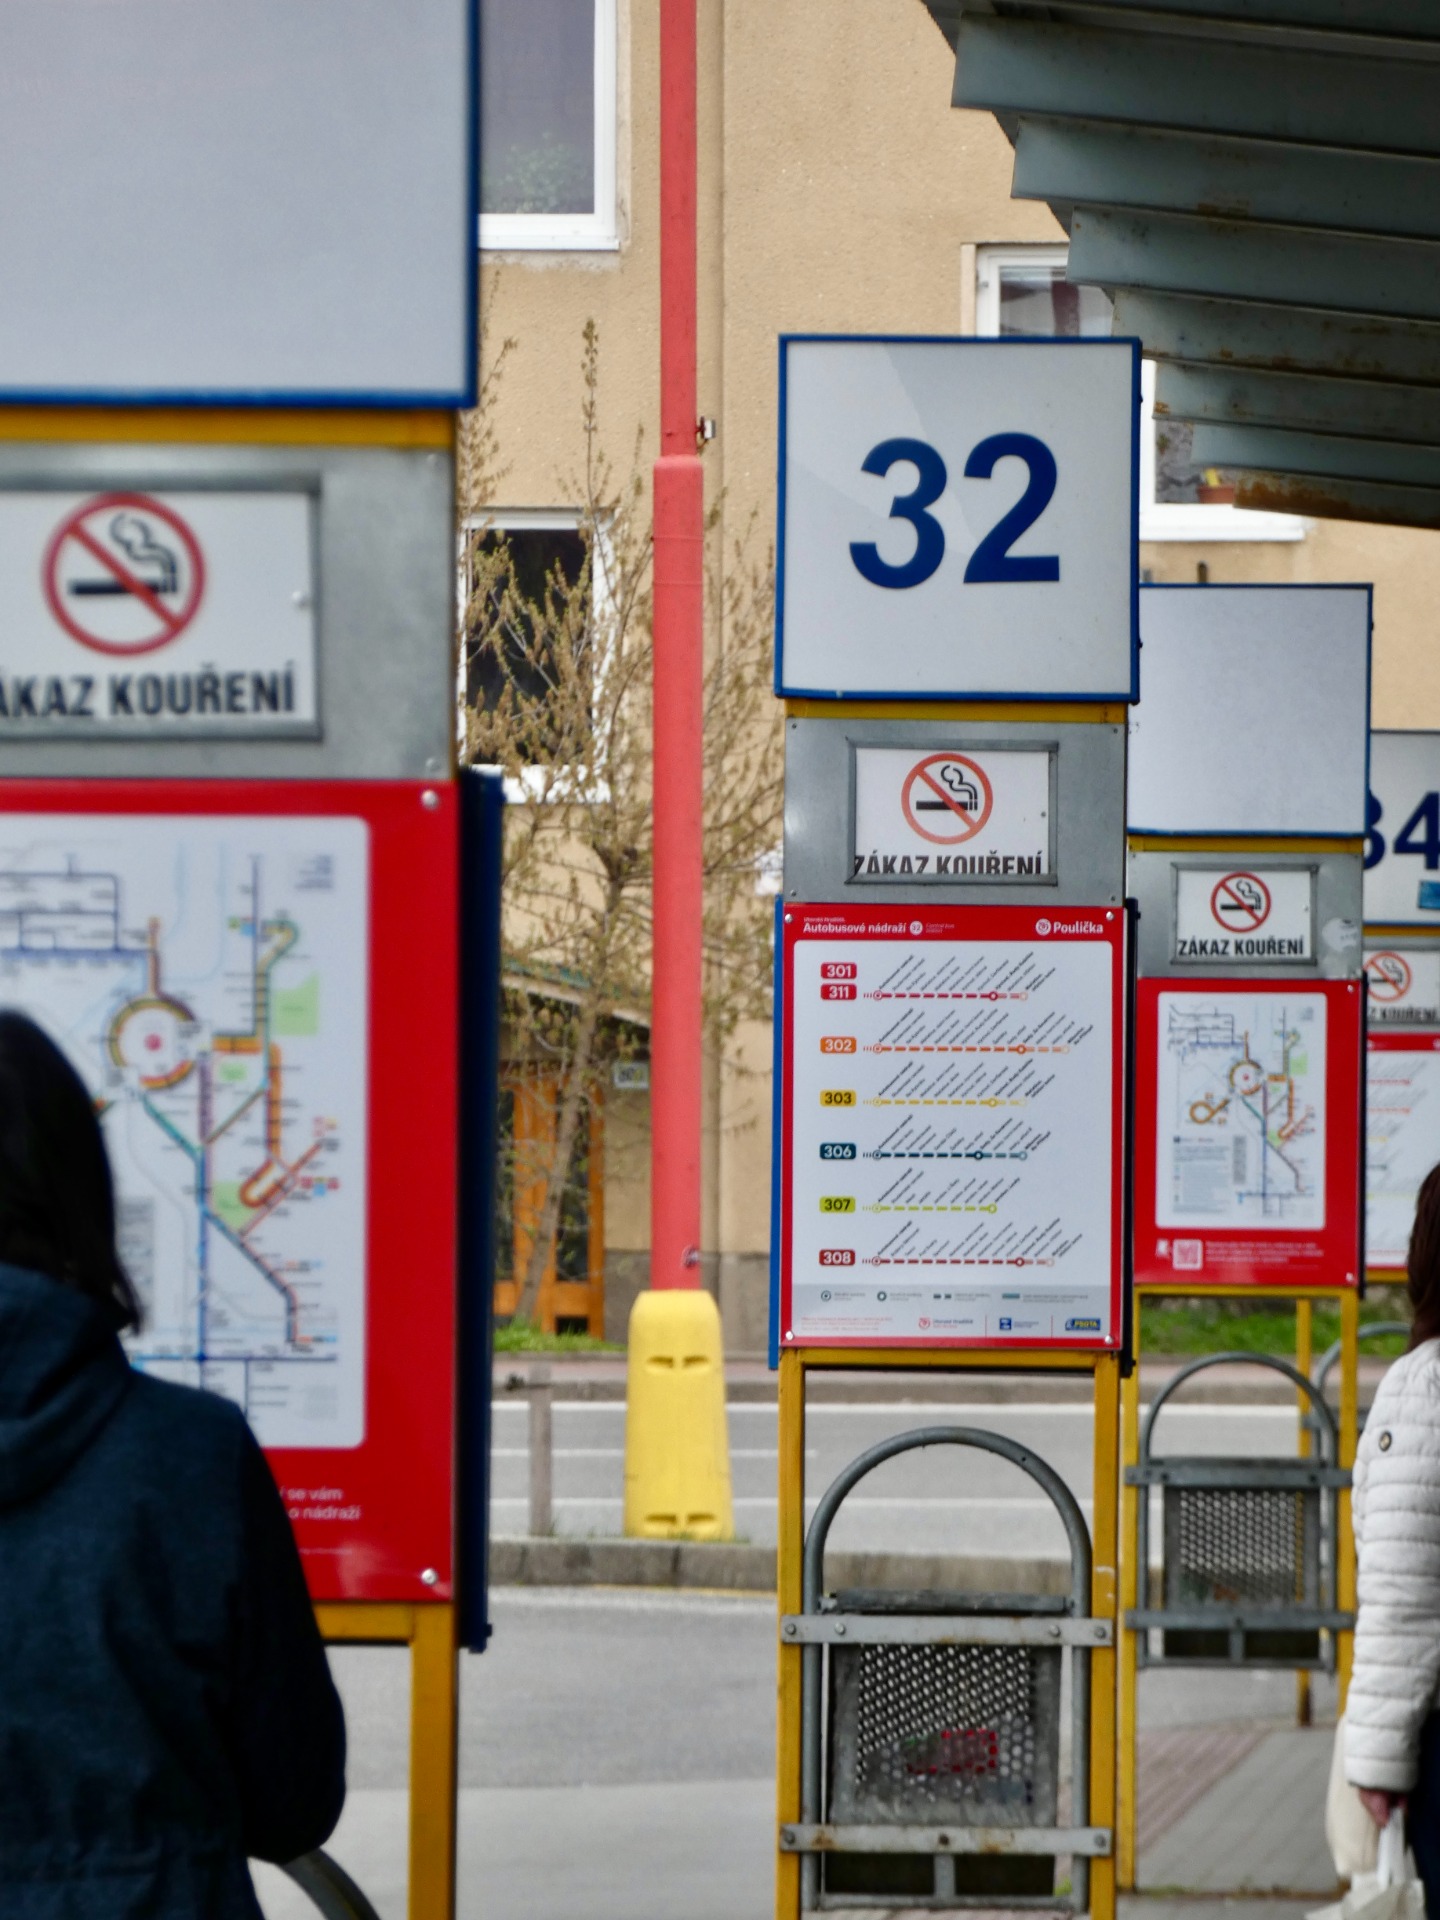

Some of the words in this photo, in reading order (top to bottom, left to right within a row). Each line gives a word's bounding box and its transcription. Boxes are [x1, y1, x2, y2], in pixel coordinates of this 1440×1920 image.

[849, 432, 1060, 589] 32
[108, 659, 296, 716] KOUŘENÍ
[854, 849, 929, 875] ZÁKAZ
[936, 850, 1043, 875] KOUŘENÍ
[803, 922, 866, 934] Autobusové
[868, 922, 906, 934] nádraží
[1053, 920, 1104, 934] Poulička
[1178, 936, 1230, 956] ZÁKAZ
[1234, 934, 1304, 955] KOUŘENÍ
[827, 964, 852, 978] 301
[829, 985, 850, 999] 311
[825, 1038, 853, 1052] 302
[824, 1092, 852, 1105] 303
[824, 1145, 852, 1158] 306
[823, 1198, 851, 1211] 307
[823, 1251, 851, 1264] 308
